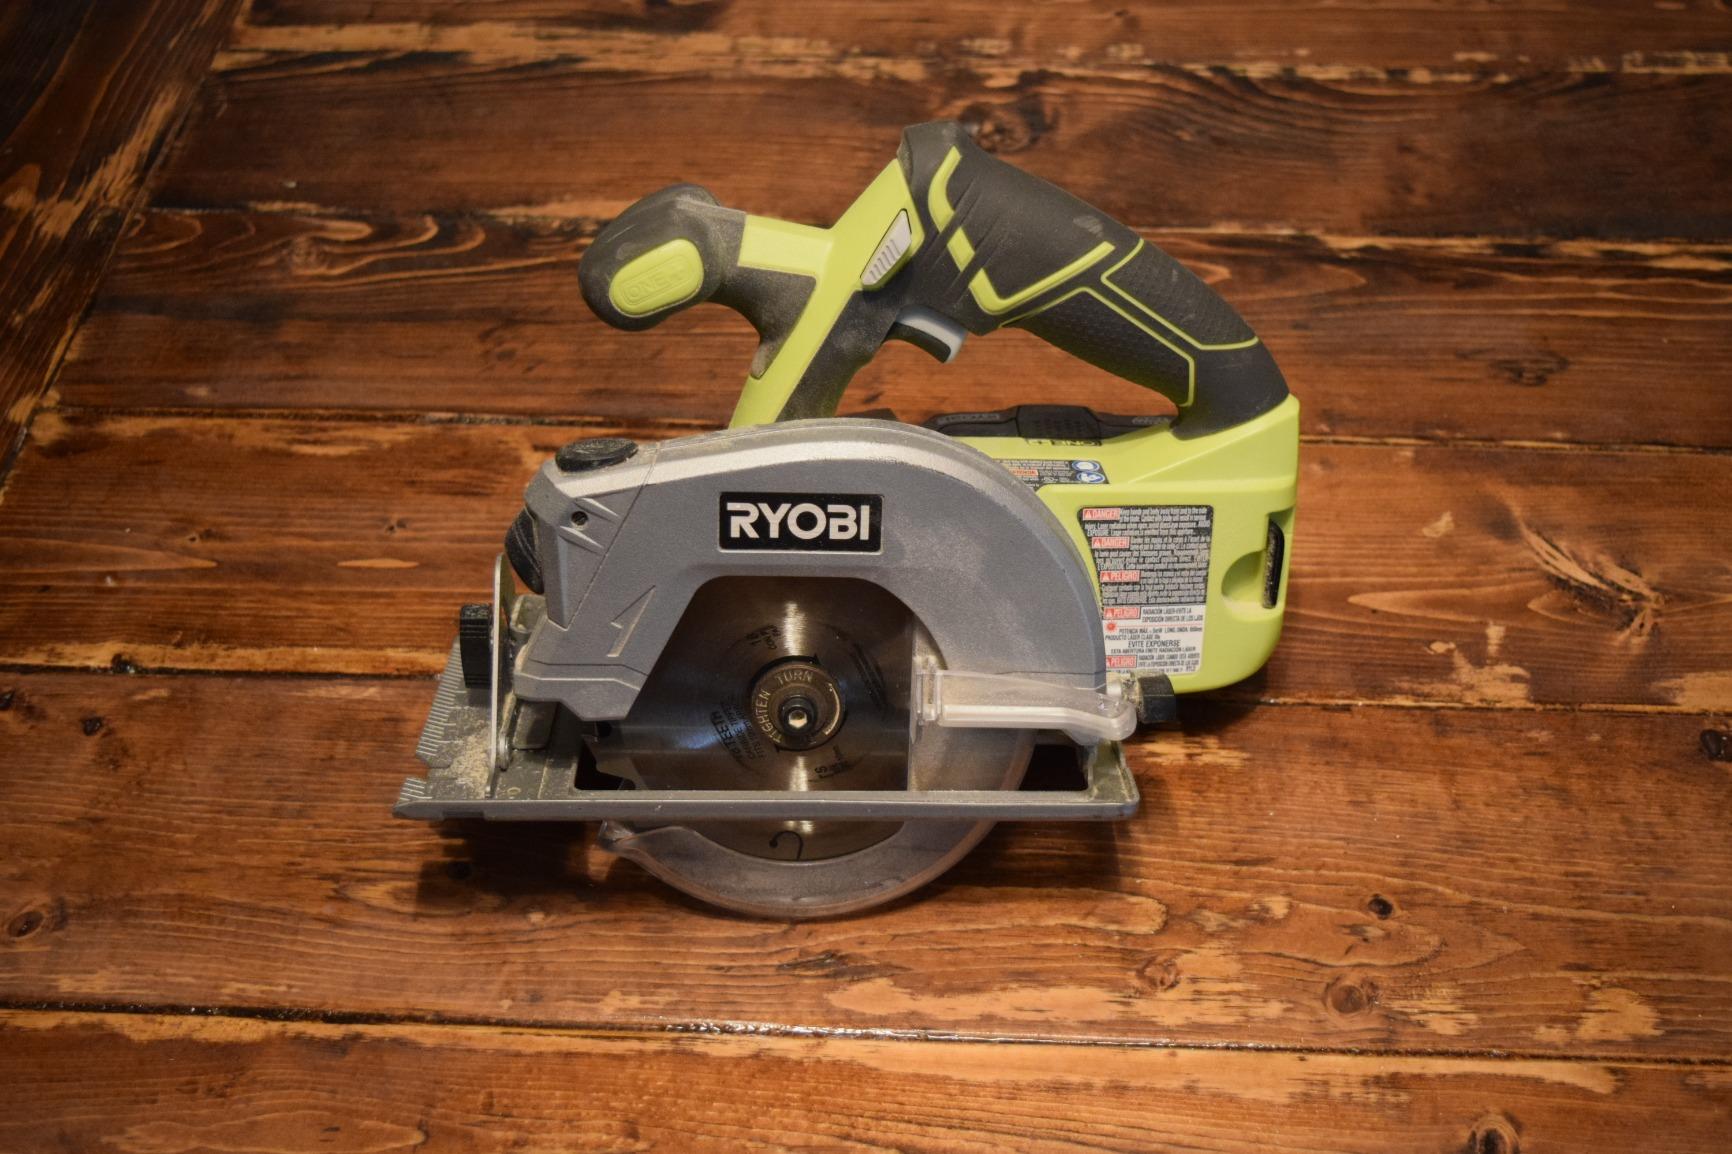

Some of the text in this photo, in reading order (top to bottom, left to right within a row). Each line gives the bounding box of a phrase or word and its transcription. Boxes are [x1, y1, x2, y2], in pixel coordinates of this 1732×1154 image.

[1092, 509, 1119, 519] DANGER
[726, 502, 871, 541] RYOBI
[1101, 538, 1129, 548] DANGER
[1110, 571, 1140, 582] PELIGRO
[1112, 607, 1139, 617] PELIGRO
[1128, 639, 1181, 648] EVITE EXPONERSE
[1110, 656, 1136, 668] PELIGRO
[756, 670, 814, 743] TIGHTEN TURN
